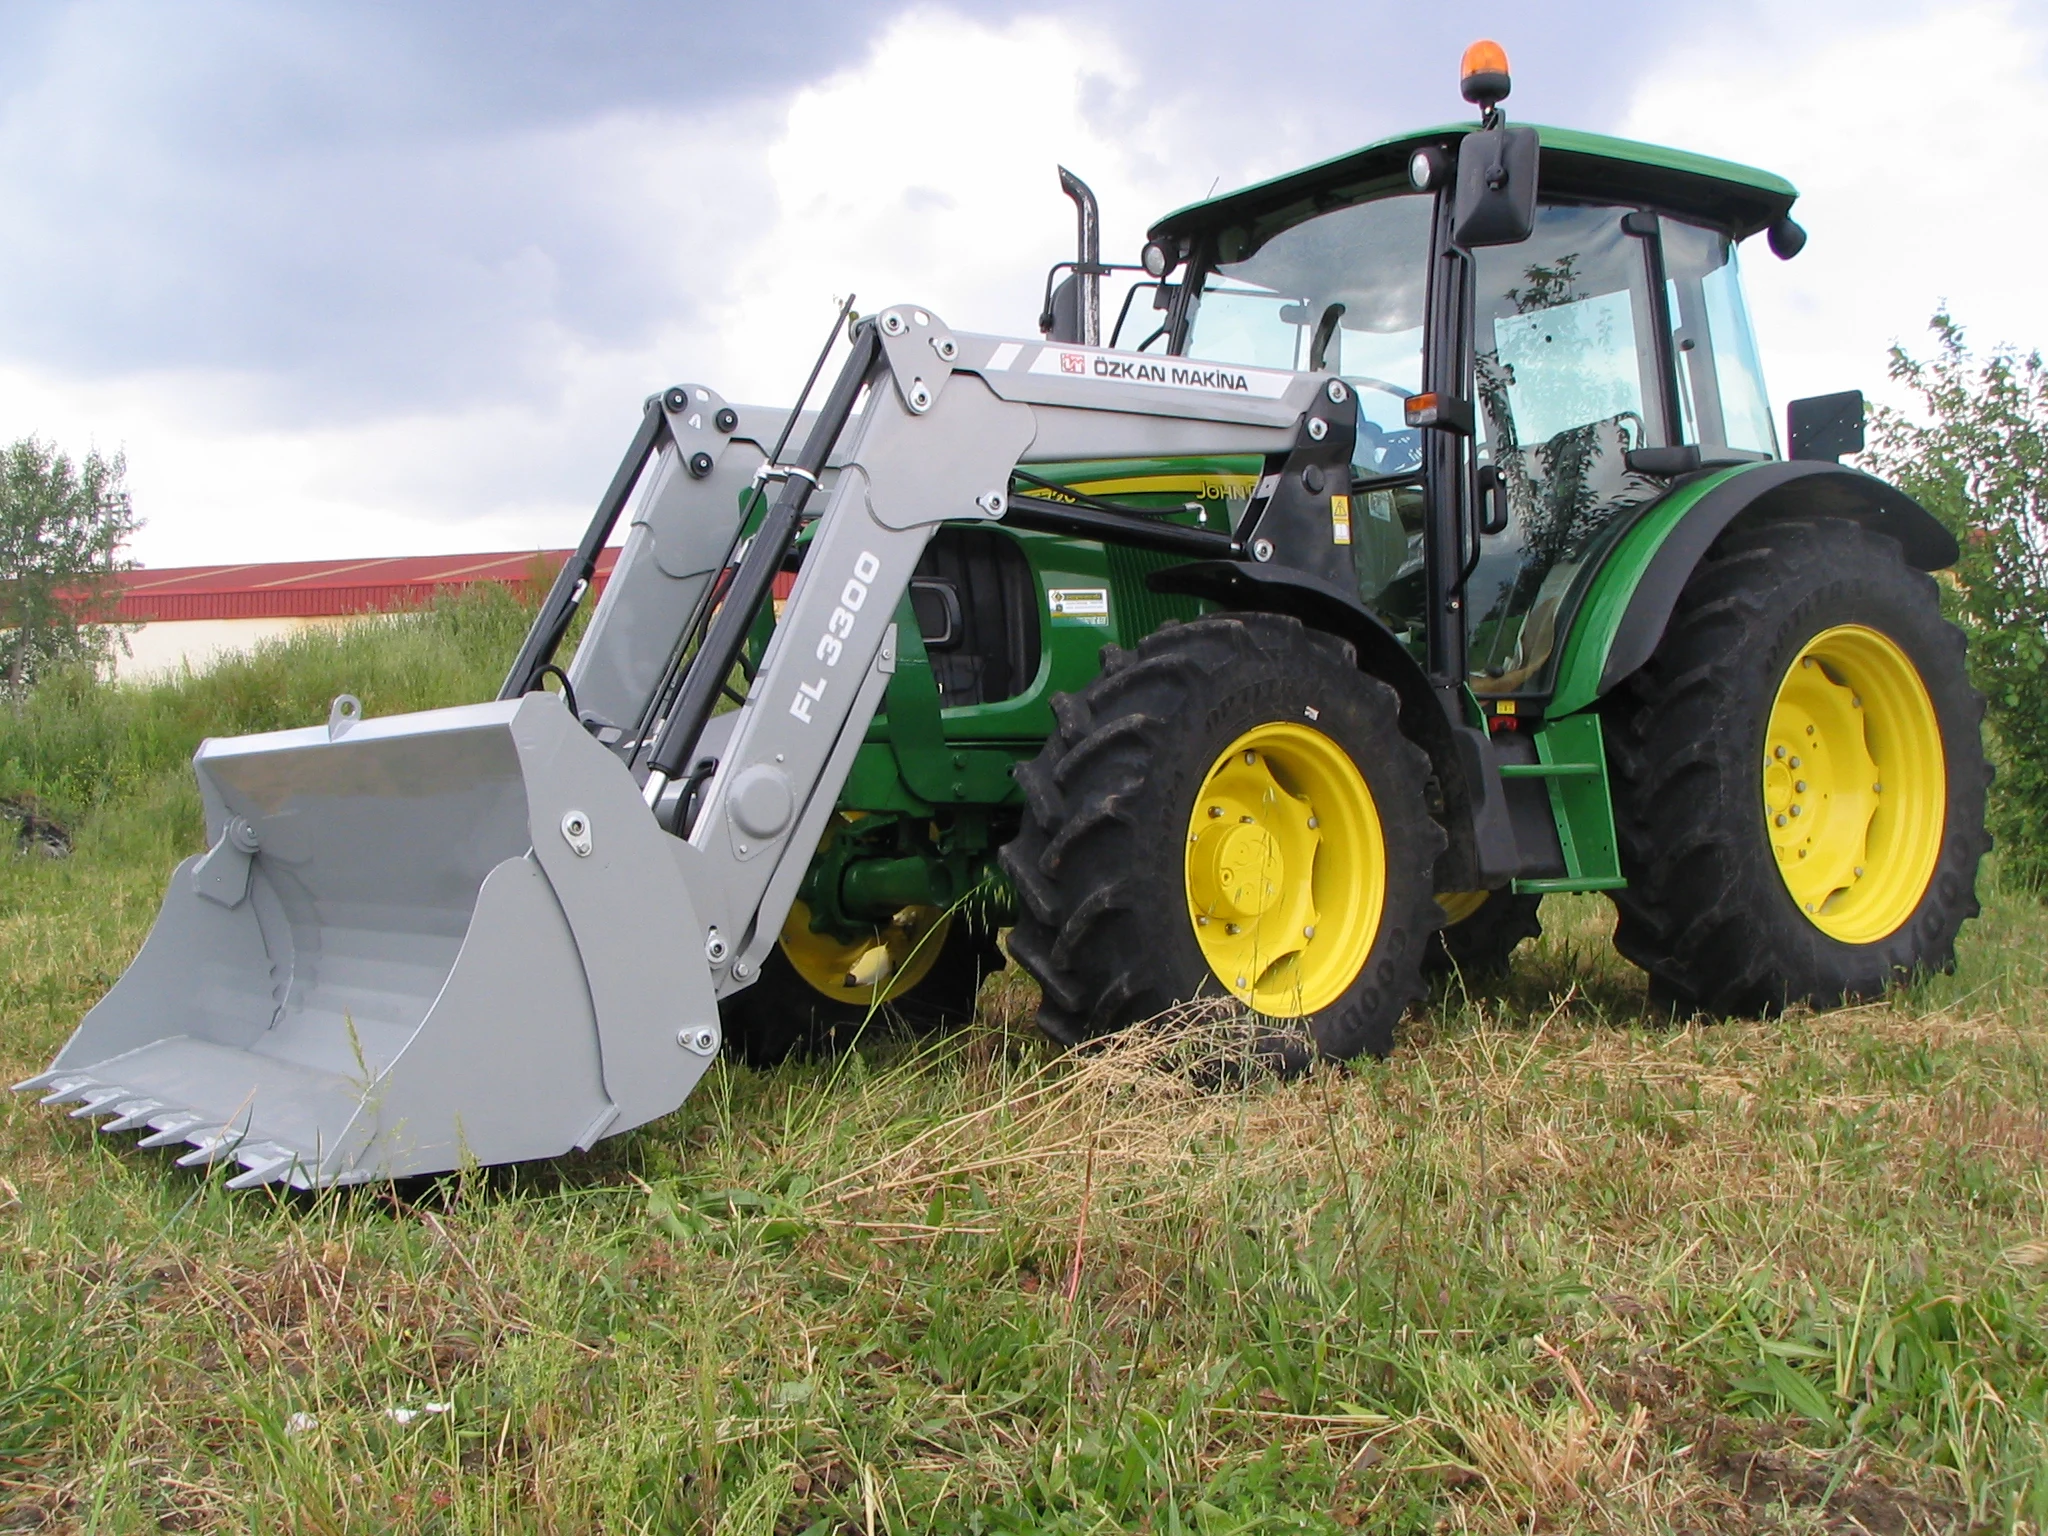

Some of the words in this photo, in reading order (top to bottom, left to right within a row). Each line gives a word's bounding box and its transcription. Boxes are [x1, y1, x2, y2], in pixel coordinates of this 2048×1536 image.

[1094, 355, 1166, 383] ÖZKAN
[1172, 369, 1249, 392] MAKİNA
[1196, 480, 1247, 501] JOHN
[789, 677, 828, 725] FL
[816, 550, 880, 668] 3300
